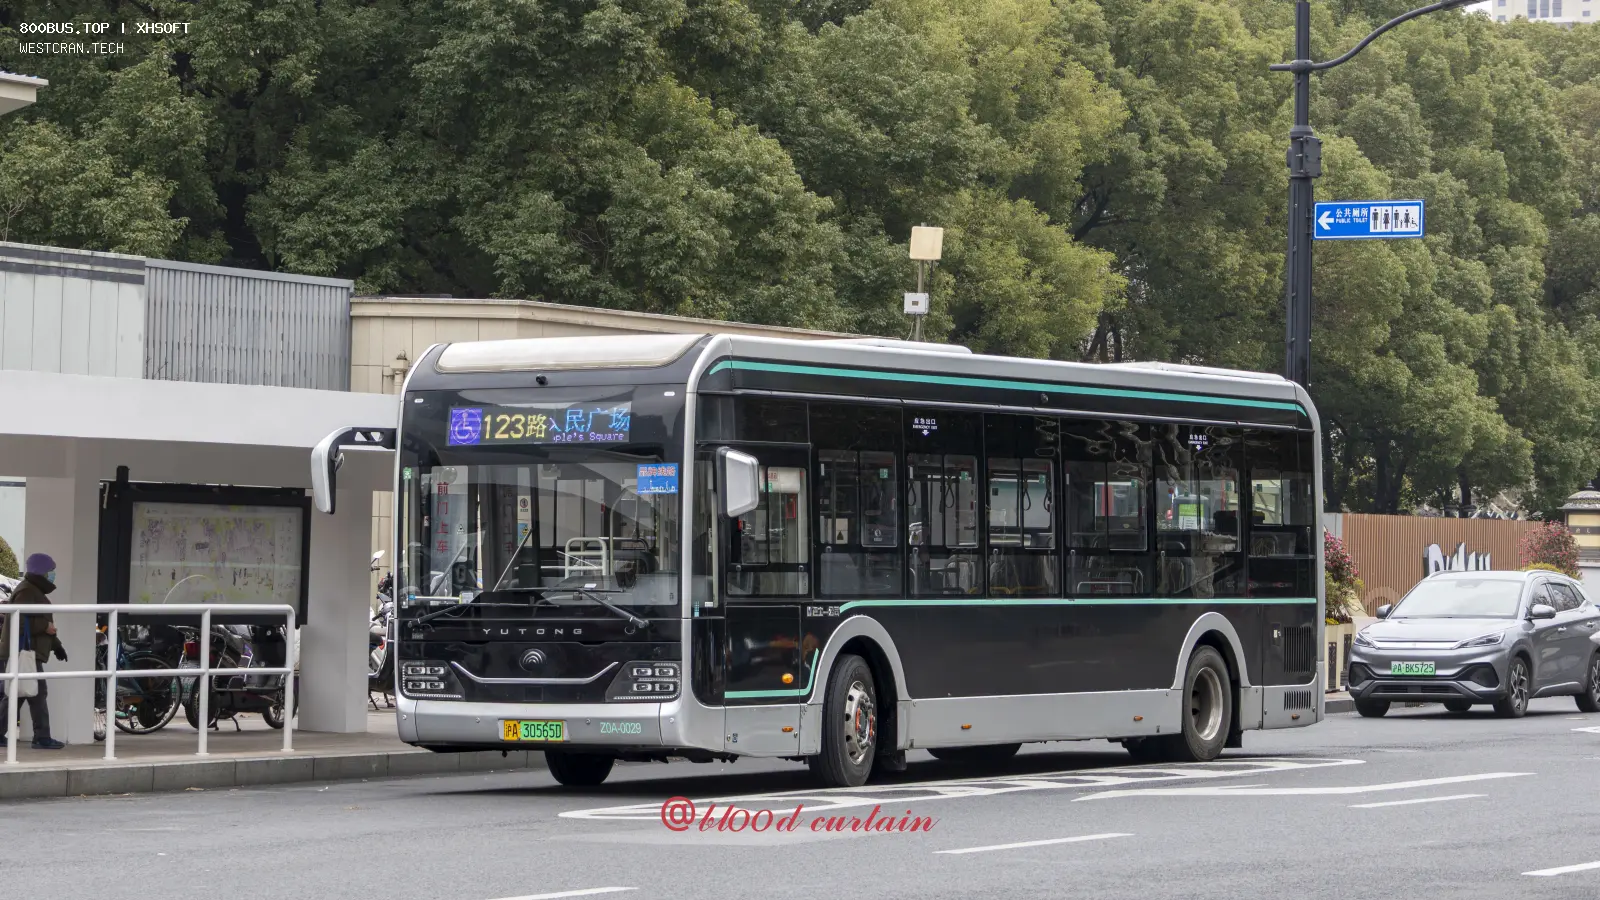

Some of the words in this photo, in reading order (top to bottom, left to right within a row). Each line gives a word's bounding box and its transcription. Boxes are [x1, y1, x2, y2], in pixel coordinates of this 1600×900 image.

[484, 414, 547, 439] 123路
[553, 432, 584, 443] ple's
[589, 432, 625, 443] Square
[436, 481, 449, 553] 前门上车
[482, 627, 583, 635] YUTONG
[1405, 663, 1434, 673] BK5725
[505, 723, 519, 738] 沪A
[523, 723, 562, 739] 30565D
